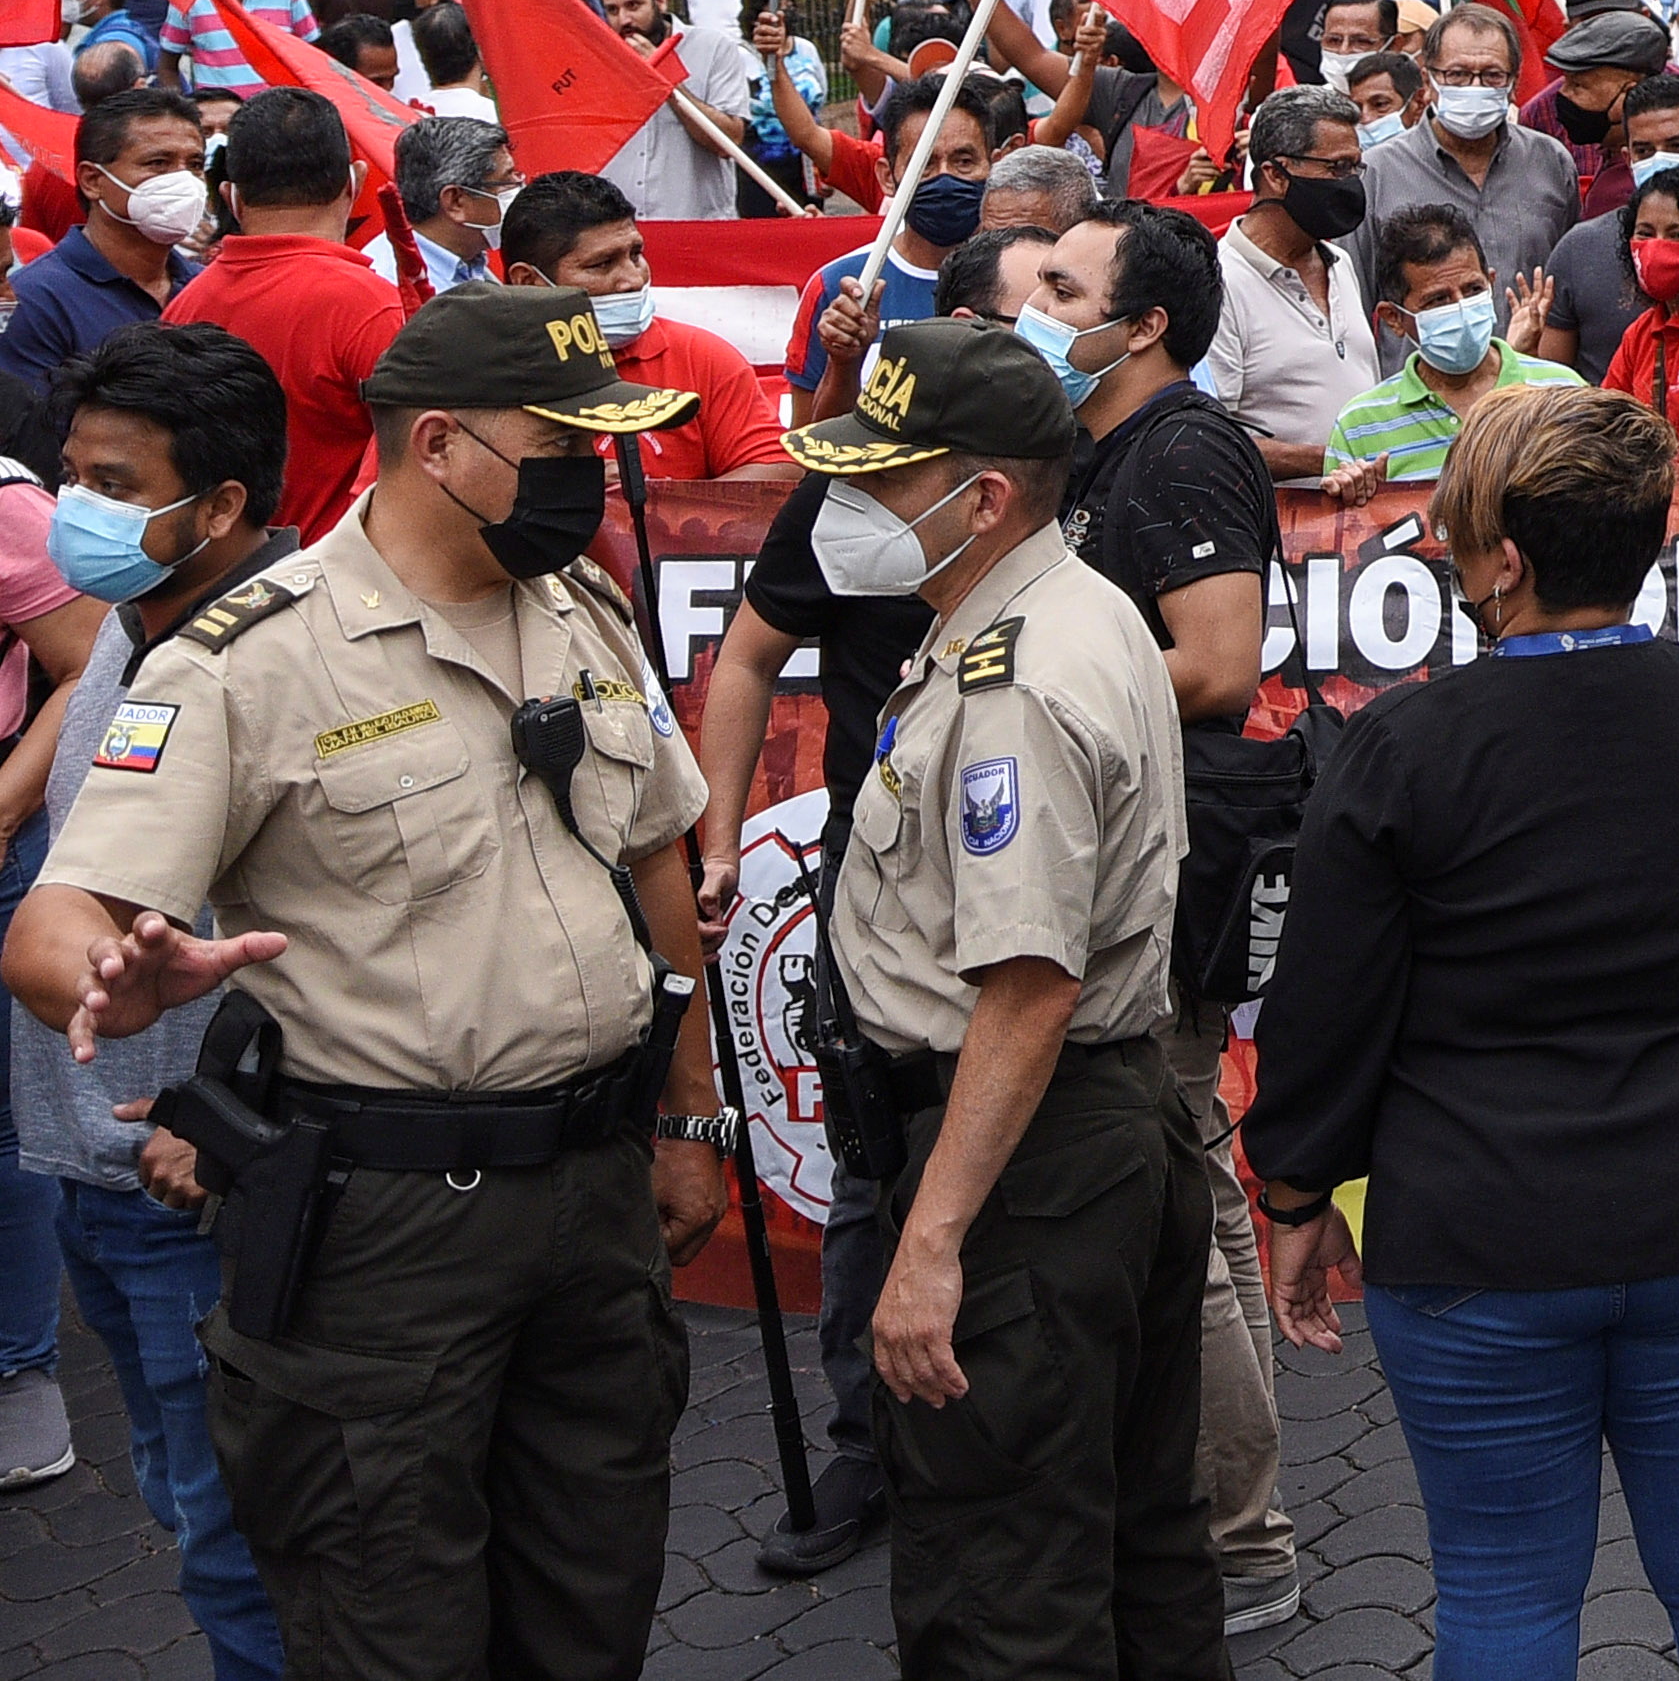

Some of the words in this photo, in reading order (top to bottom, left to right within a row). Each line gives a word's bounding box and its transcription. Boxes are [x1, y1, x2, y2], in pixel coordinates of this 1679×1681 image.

[552, 68, 577, 95] FUT
[546, 312, 608, 361] POL
[864, 356, 916, 417] ICÍA
[859, 394, 901, 432] ONAL
[118, 706, 170, 722] ADOR
[964, 766, 1006, 785] ECUADOR
[727, 935, 786, 1108] Federación
